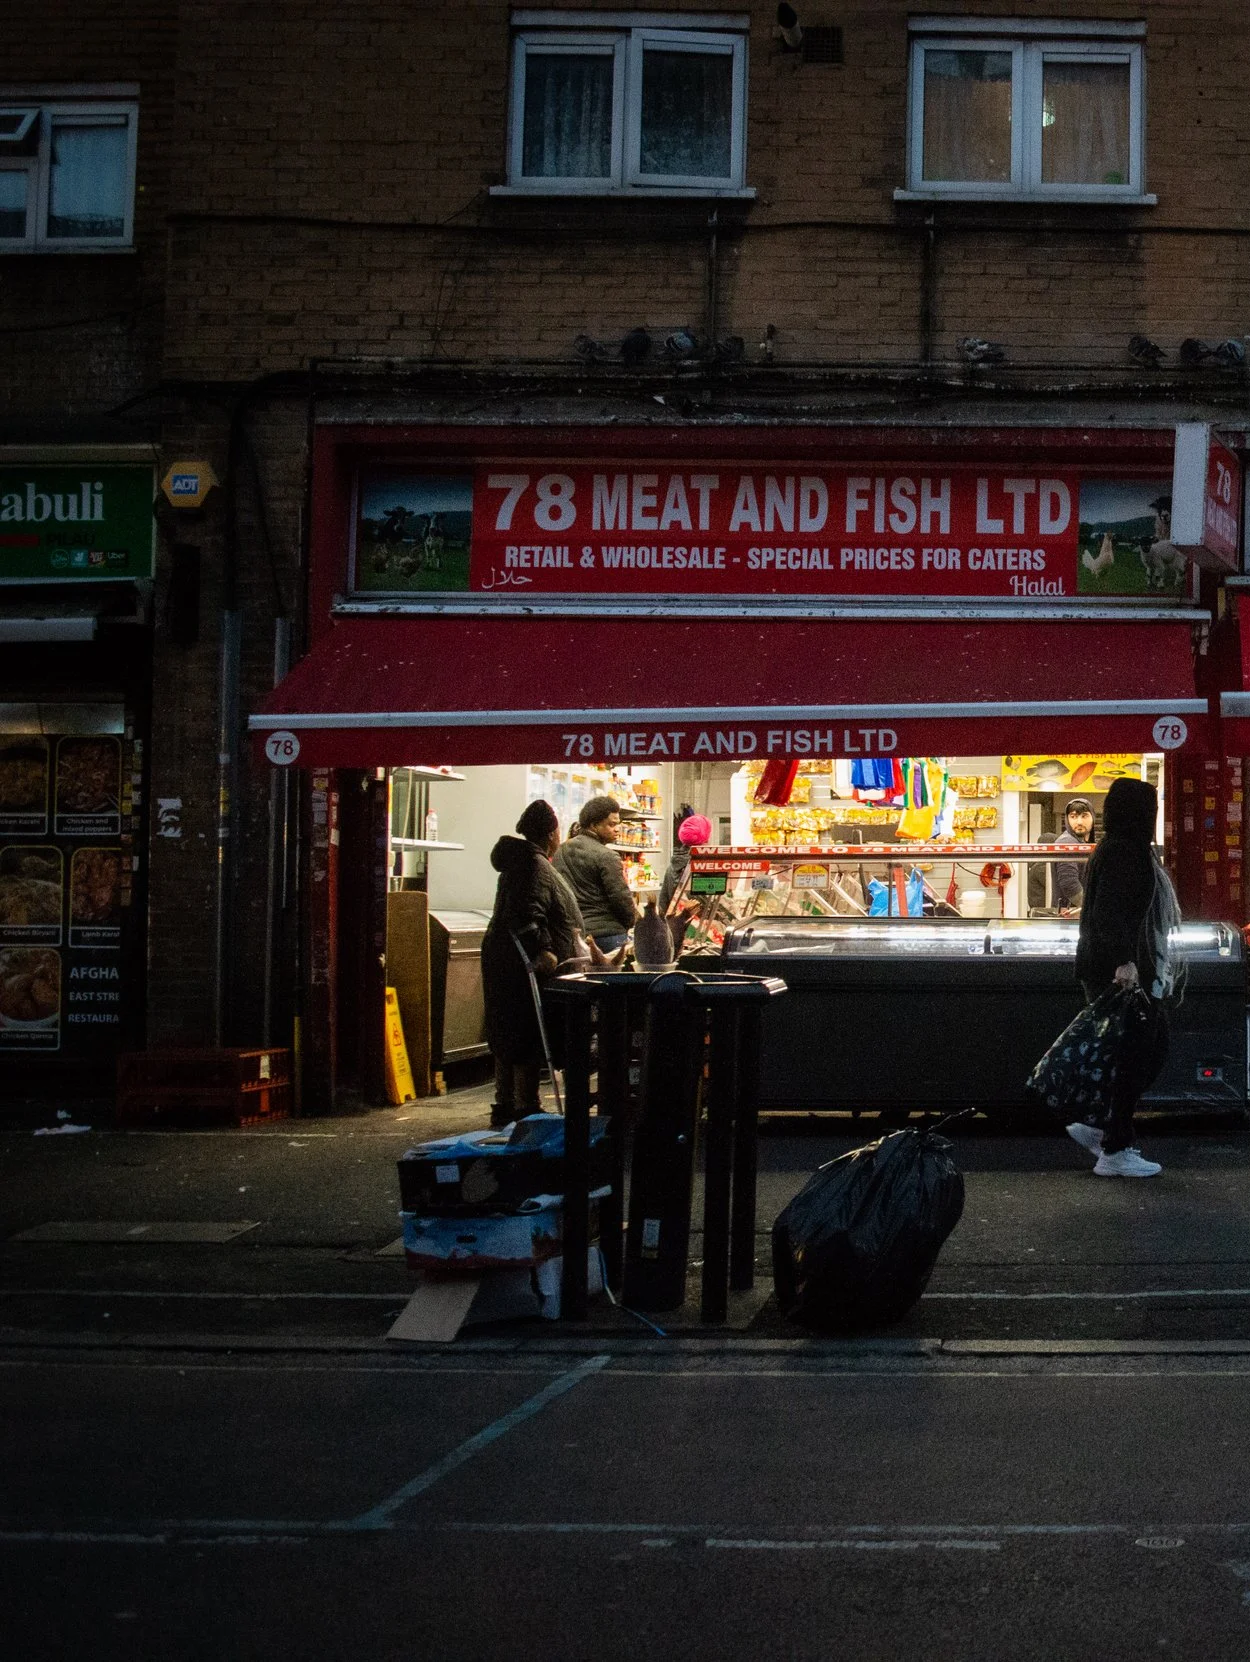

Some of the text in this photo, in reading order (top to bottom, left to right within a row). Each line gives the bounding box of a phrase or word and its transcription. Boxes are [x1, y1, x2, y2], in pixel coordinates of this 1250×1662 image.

[172, 478, 199, 491] ADT
[487, 474, 1072, 536] 78 MEAT AND FISH LTD
[504, 545, 575, 569] RETAIL
[578, 547, 596, 569] &
[601, 546, 726, 569] WHOLESALE
[747, 547, 834, 570] SPECIAL
[840, 548, 916, 571] PRICES
[922, 548, 961, 571] FOR
[967, 549, 1046, 571] CATERS
[481, 566, 533, 589] حلال
[1008, 574, 1067, 597] Halal
[1158, 724, 1182, 742] 78
[270, 740, 294, 757] 78
[562, 728, 898, 756] 78 MEAT AND FISH LTD
[696, 846, 812, 854] WELCOME
[693, 862, 762, 871] WELCOME
[69, 967, 120, 980] AFGHA
[69, 991, 95, 1002] EAST
[68, 1013, 120, 1024] RESTAURA
